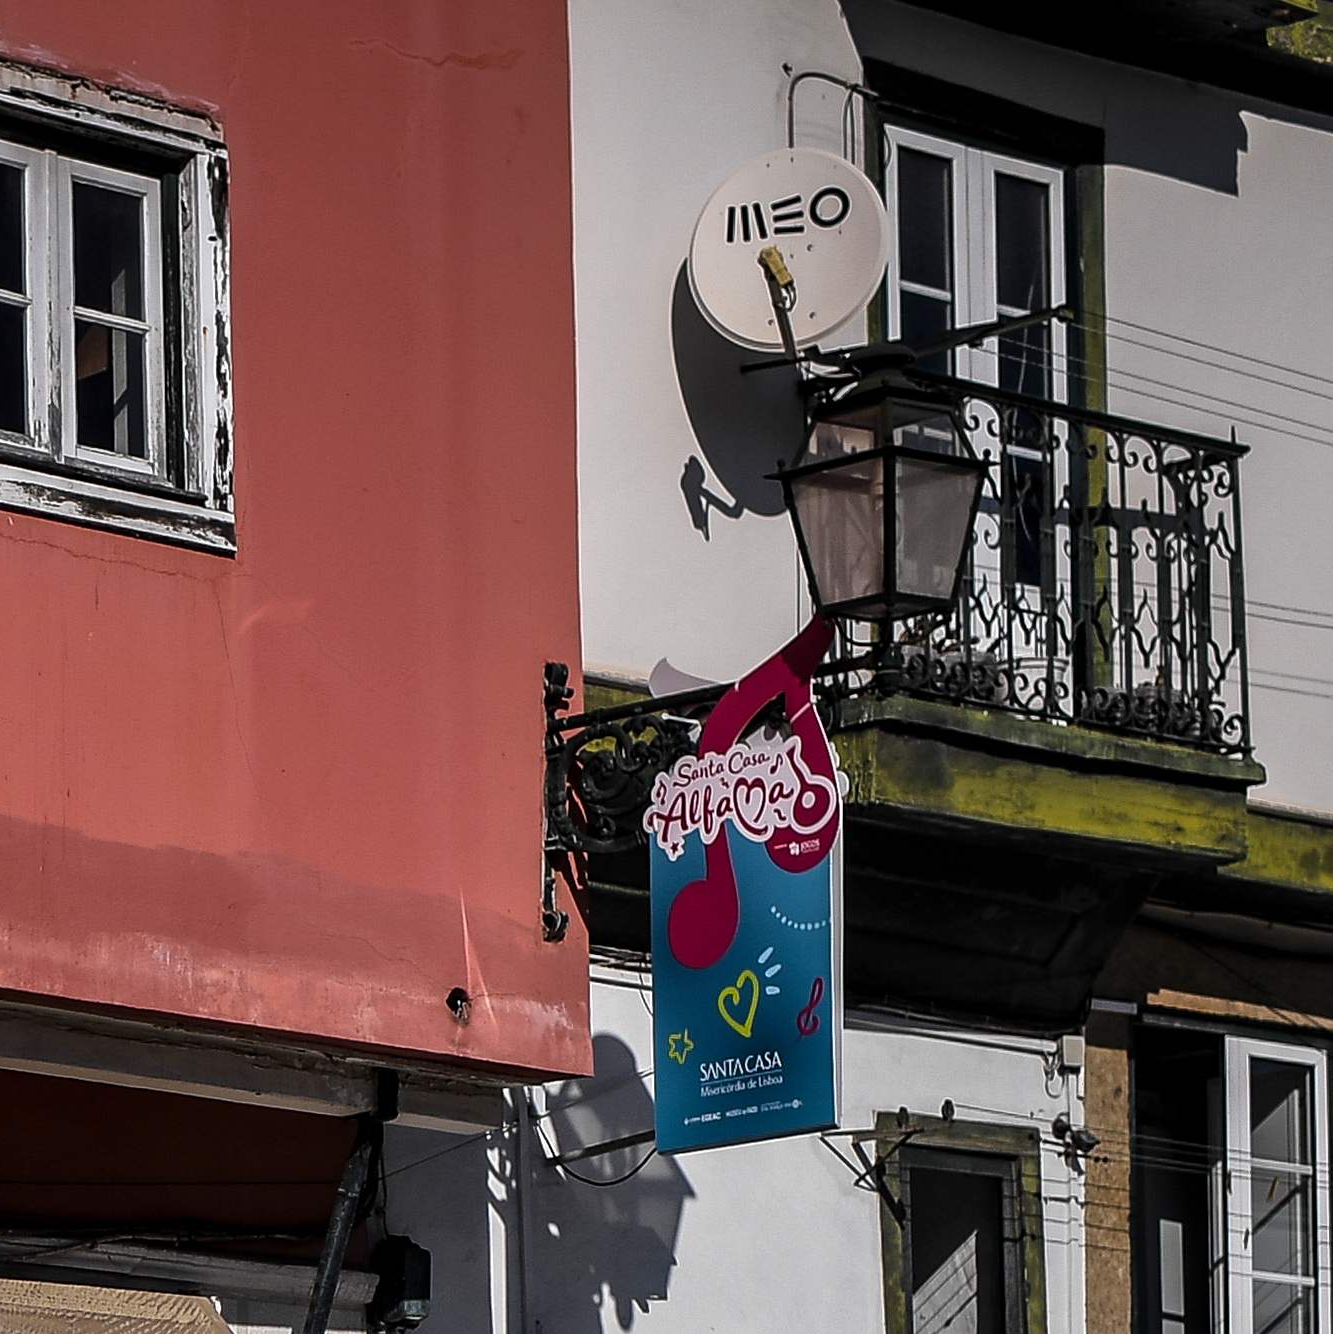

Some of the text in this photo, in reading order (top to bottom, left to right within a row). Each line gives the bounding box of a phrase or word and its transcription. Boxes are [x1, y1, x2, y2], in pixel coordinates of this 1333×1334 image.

[727, 187, 851, 243] MEO
[673, 751, 770, 788] Santa Casa
[700, 1051, 782, 1082] SANTA CASA
[758, 1074, 783, 1088] Lisboa
